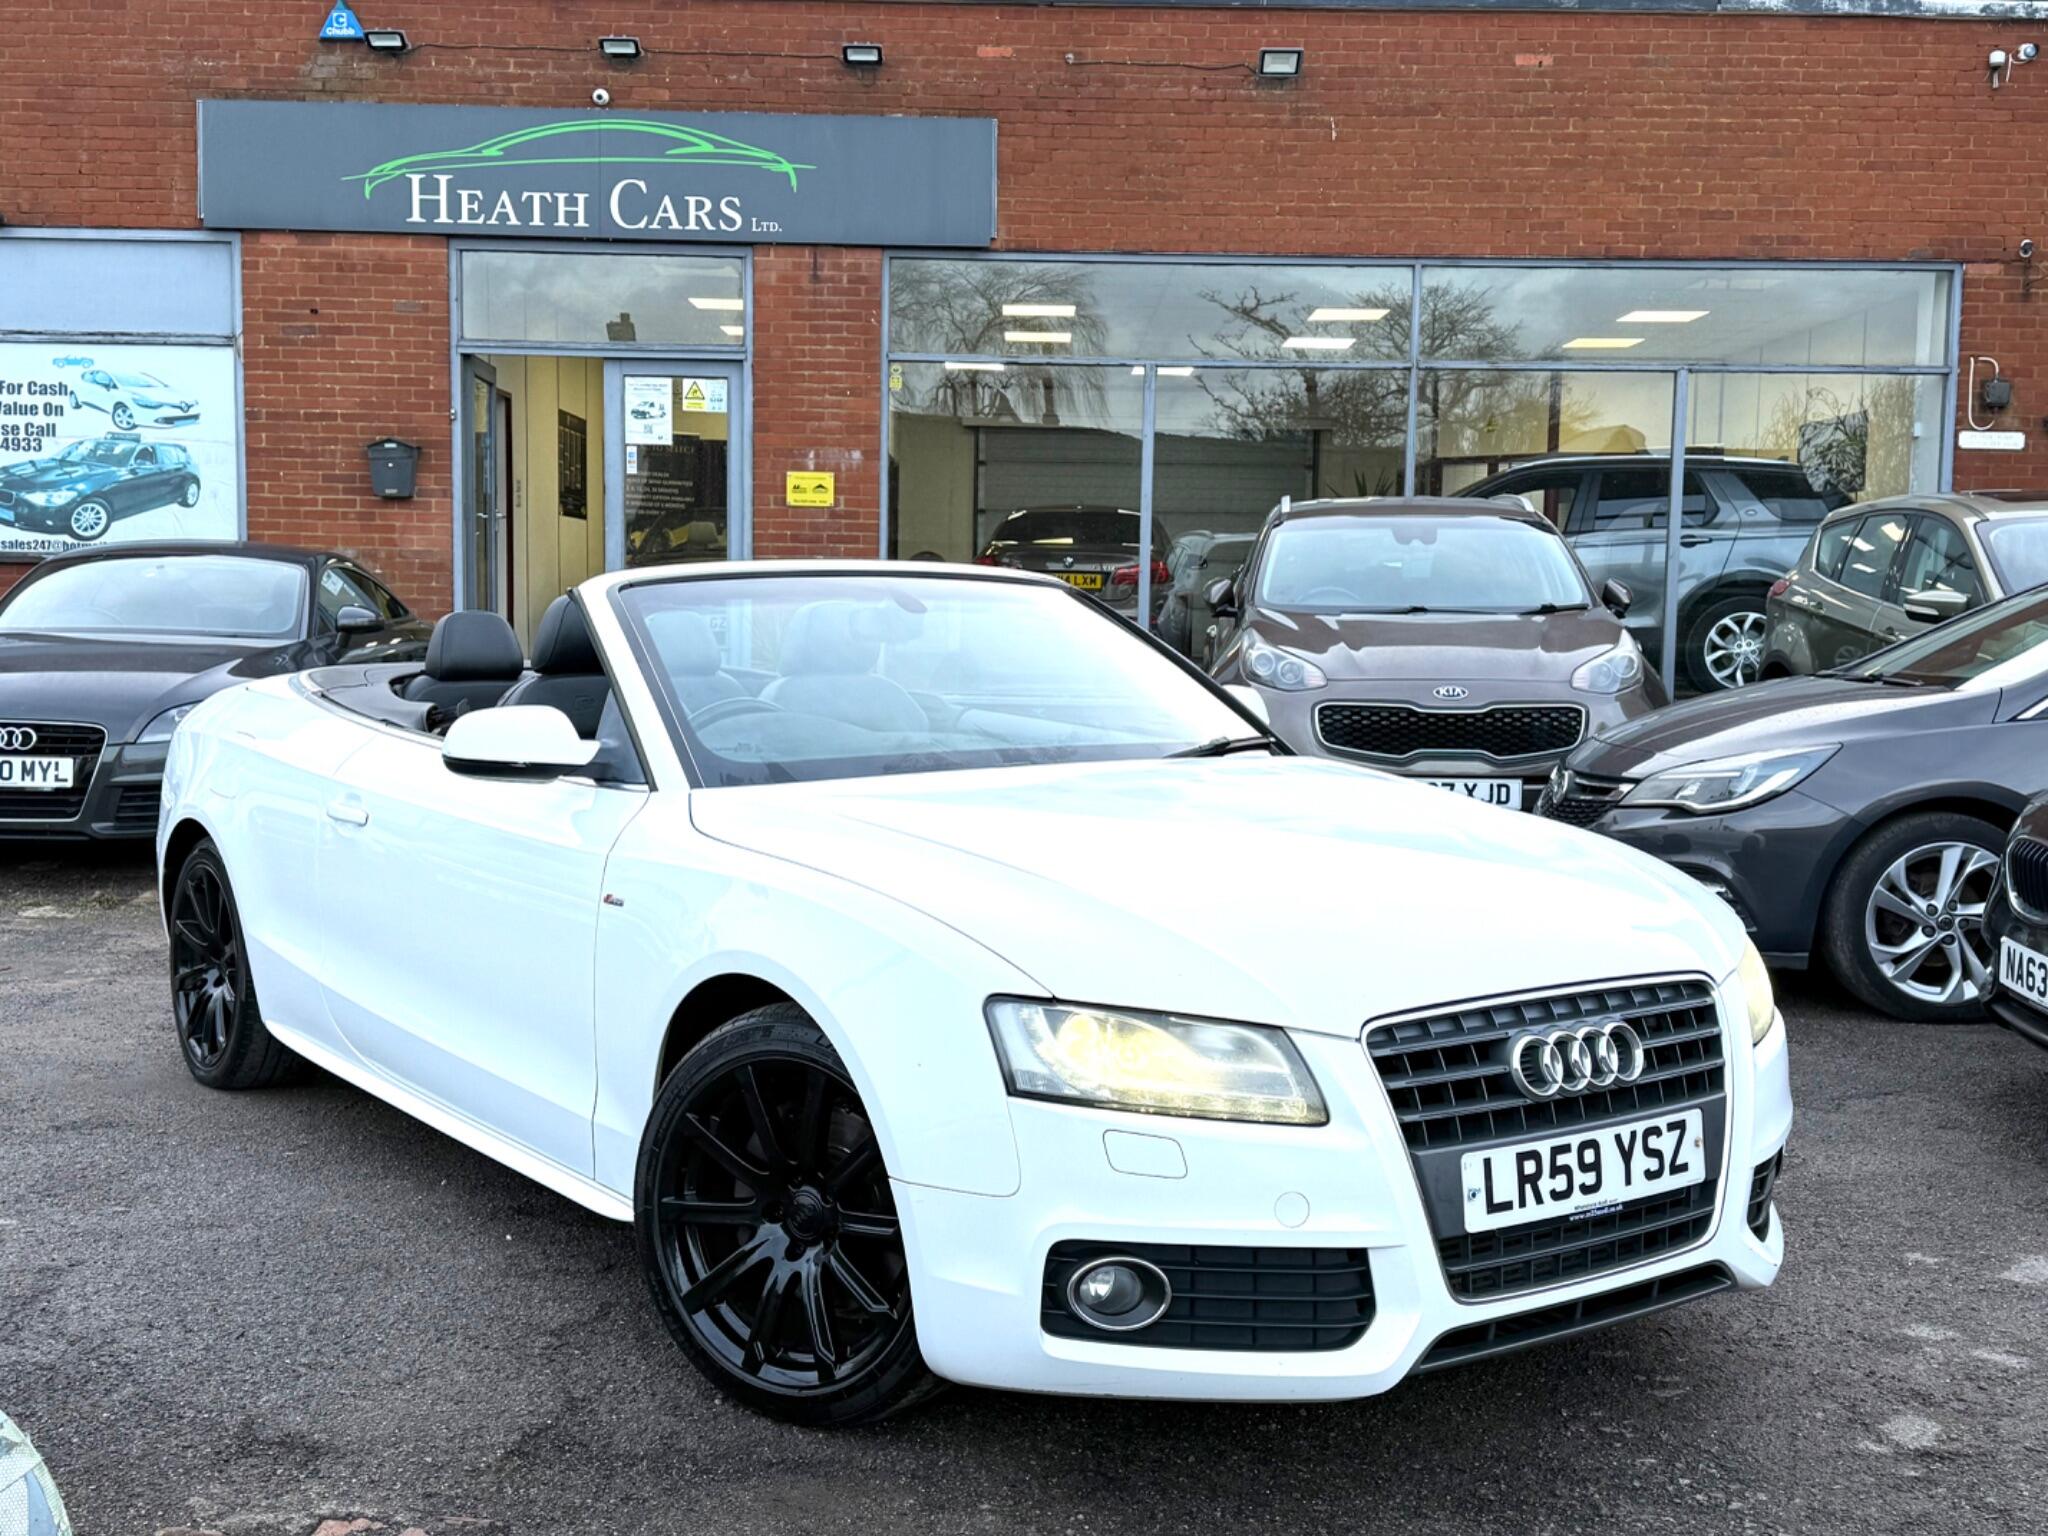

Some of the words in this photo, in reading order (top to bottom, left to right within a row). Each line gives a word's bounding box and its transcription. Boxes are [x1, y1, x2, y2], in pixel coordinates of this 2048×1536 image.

[405, 173, 590, 227] HEATH
[609, 178, 743, 232] CARS
[0, 380, 23, 395] For
[27, 380, 68, 397] Cash
[0, 401, 39, 416] alue
[43, 402, 64, 417] On
[24, 422, 56, 438] Call
[0, 437, 42, 452] 4933
[1439, 687, 1465, 698] KIA
[21, 760, 68, 782] MYL
[2006, 946, 2048, 998] NA63
[1483, 1138, 1602, 1215] LR59
[1614, 1119, 1689, 1187] YSZ
